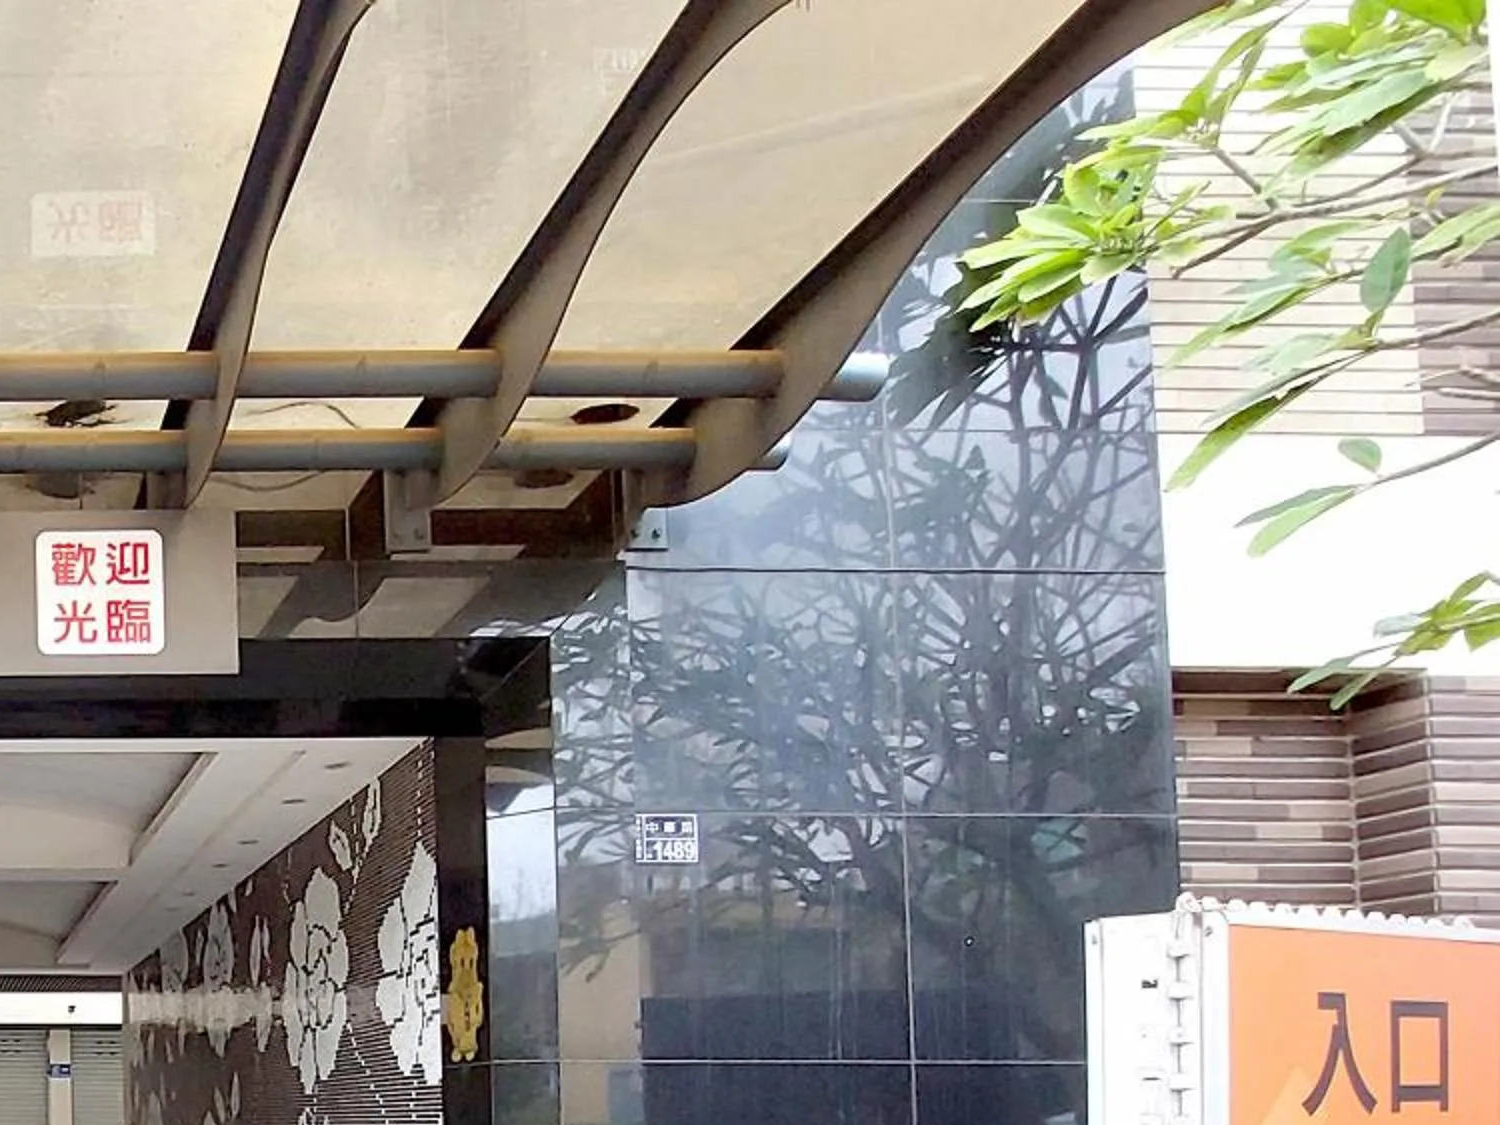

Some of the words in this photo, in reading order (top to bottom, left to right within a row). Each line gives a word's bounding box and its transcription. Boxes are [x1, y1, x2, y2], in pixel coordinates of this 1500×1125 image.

[51, 542, 150, 586] 歡迎
[53, 600, 152, 644] 光臨
[653, 840, 694, 860] 1489
[1301, 991, 1449, 1116] 入口
